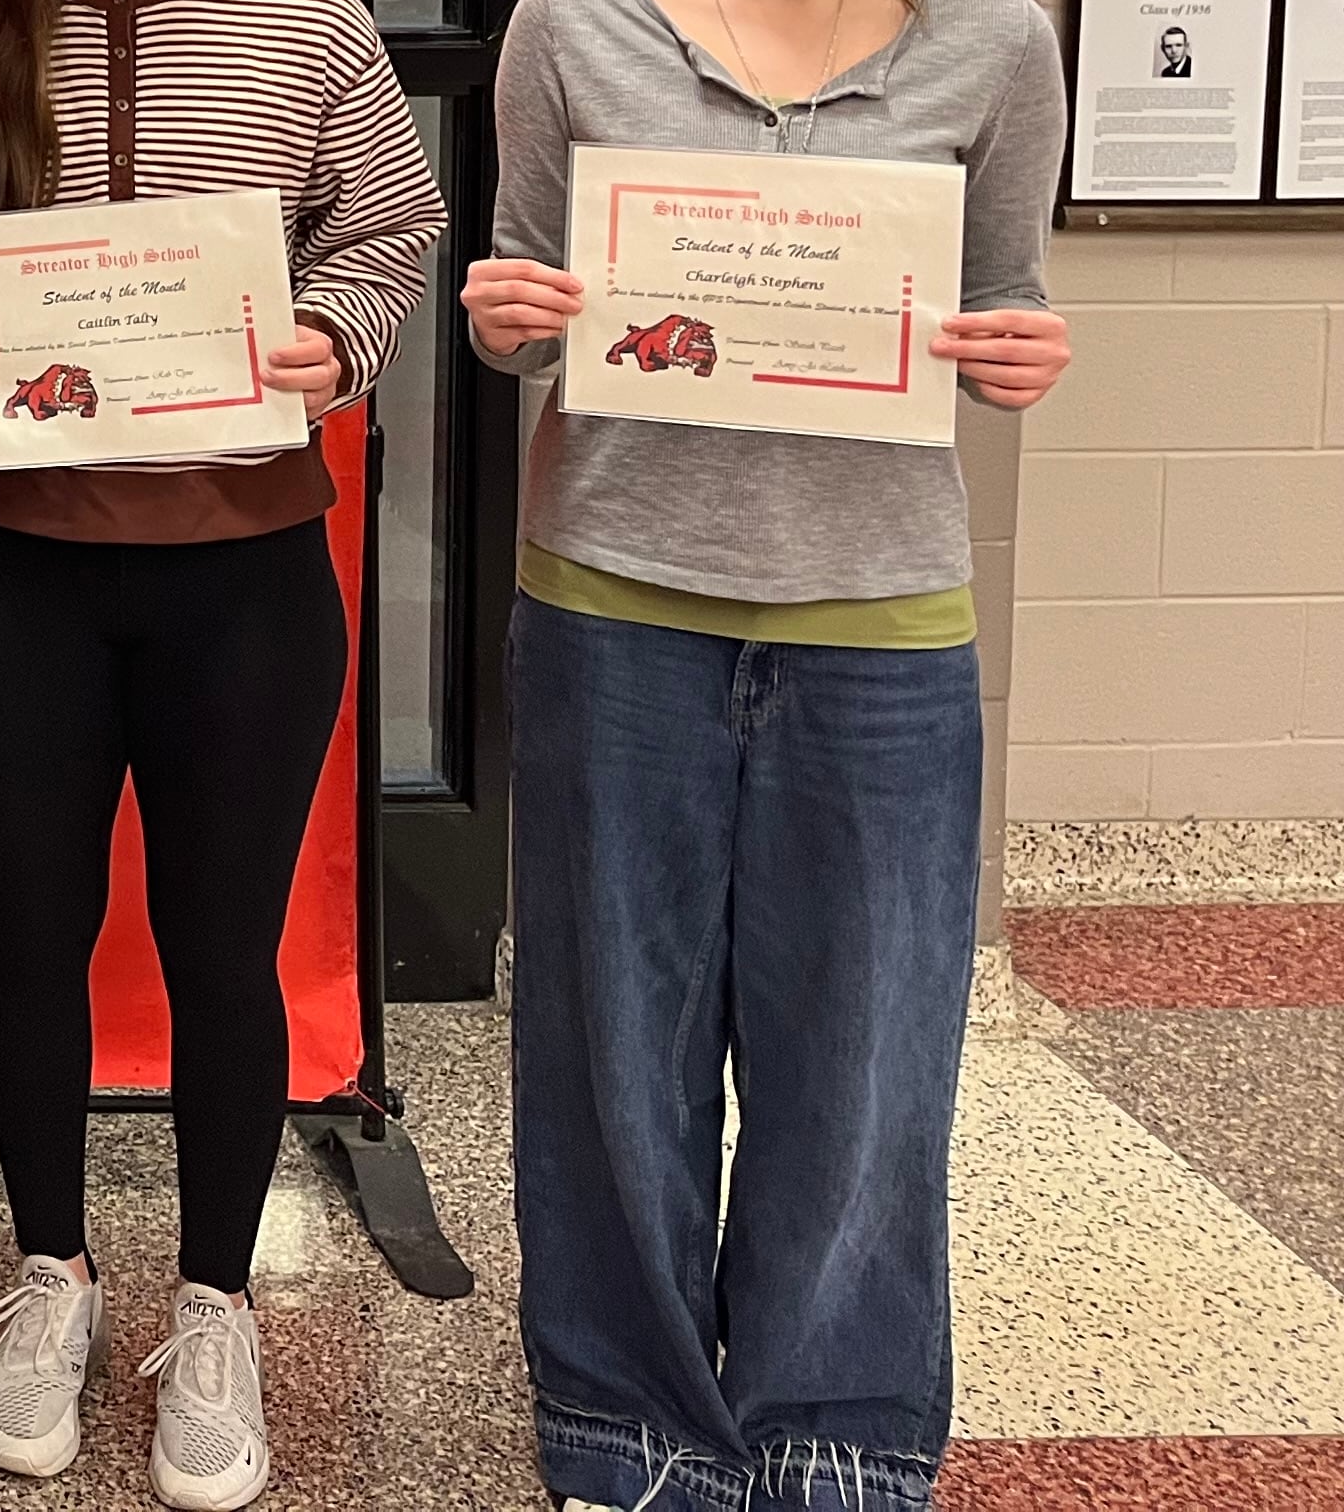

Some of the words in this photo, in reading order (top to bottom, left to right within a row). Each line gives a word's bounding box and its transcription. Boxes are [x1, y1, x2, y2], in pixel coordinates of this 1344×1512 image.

[1140, 4, 1169, 15] Class
[1171, 4, 1185, 16] of
[652, 201, 733, 221] Streator
[742, 204, 789, 226] High
[795, 210, 861, 229] School
[20, 257, 89, 276] Streator
[97, 251, 138, 269] High
[143, 245, 200, 265] School
[672, 238, 733, 253] Student
[739, 241, 753, 256] of
[761, 244, 782, 257] the
[788, 244, 839, 261] Month
[42, 290, 95, 305] Student
[100, 287, 112, 303] of
[119, 283, 137, 297] the
[142, 279, 186, 295] Month
[686, 270, 756, 288] Charleigh
[761, 275, 824, 292] Stephens
[78, 317, 120, 330] Caitlin
